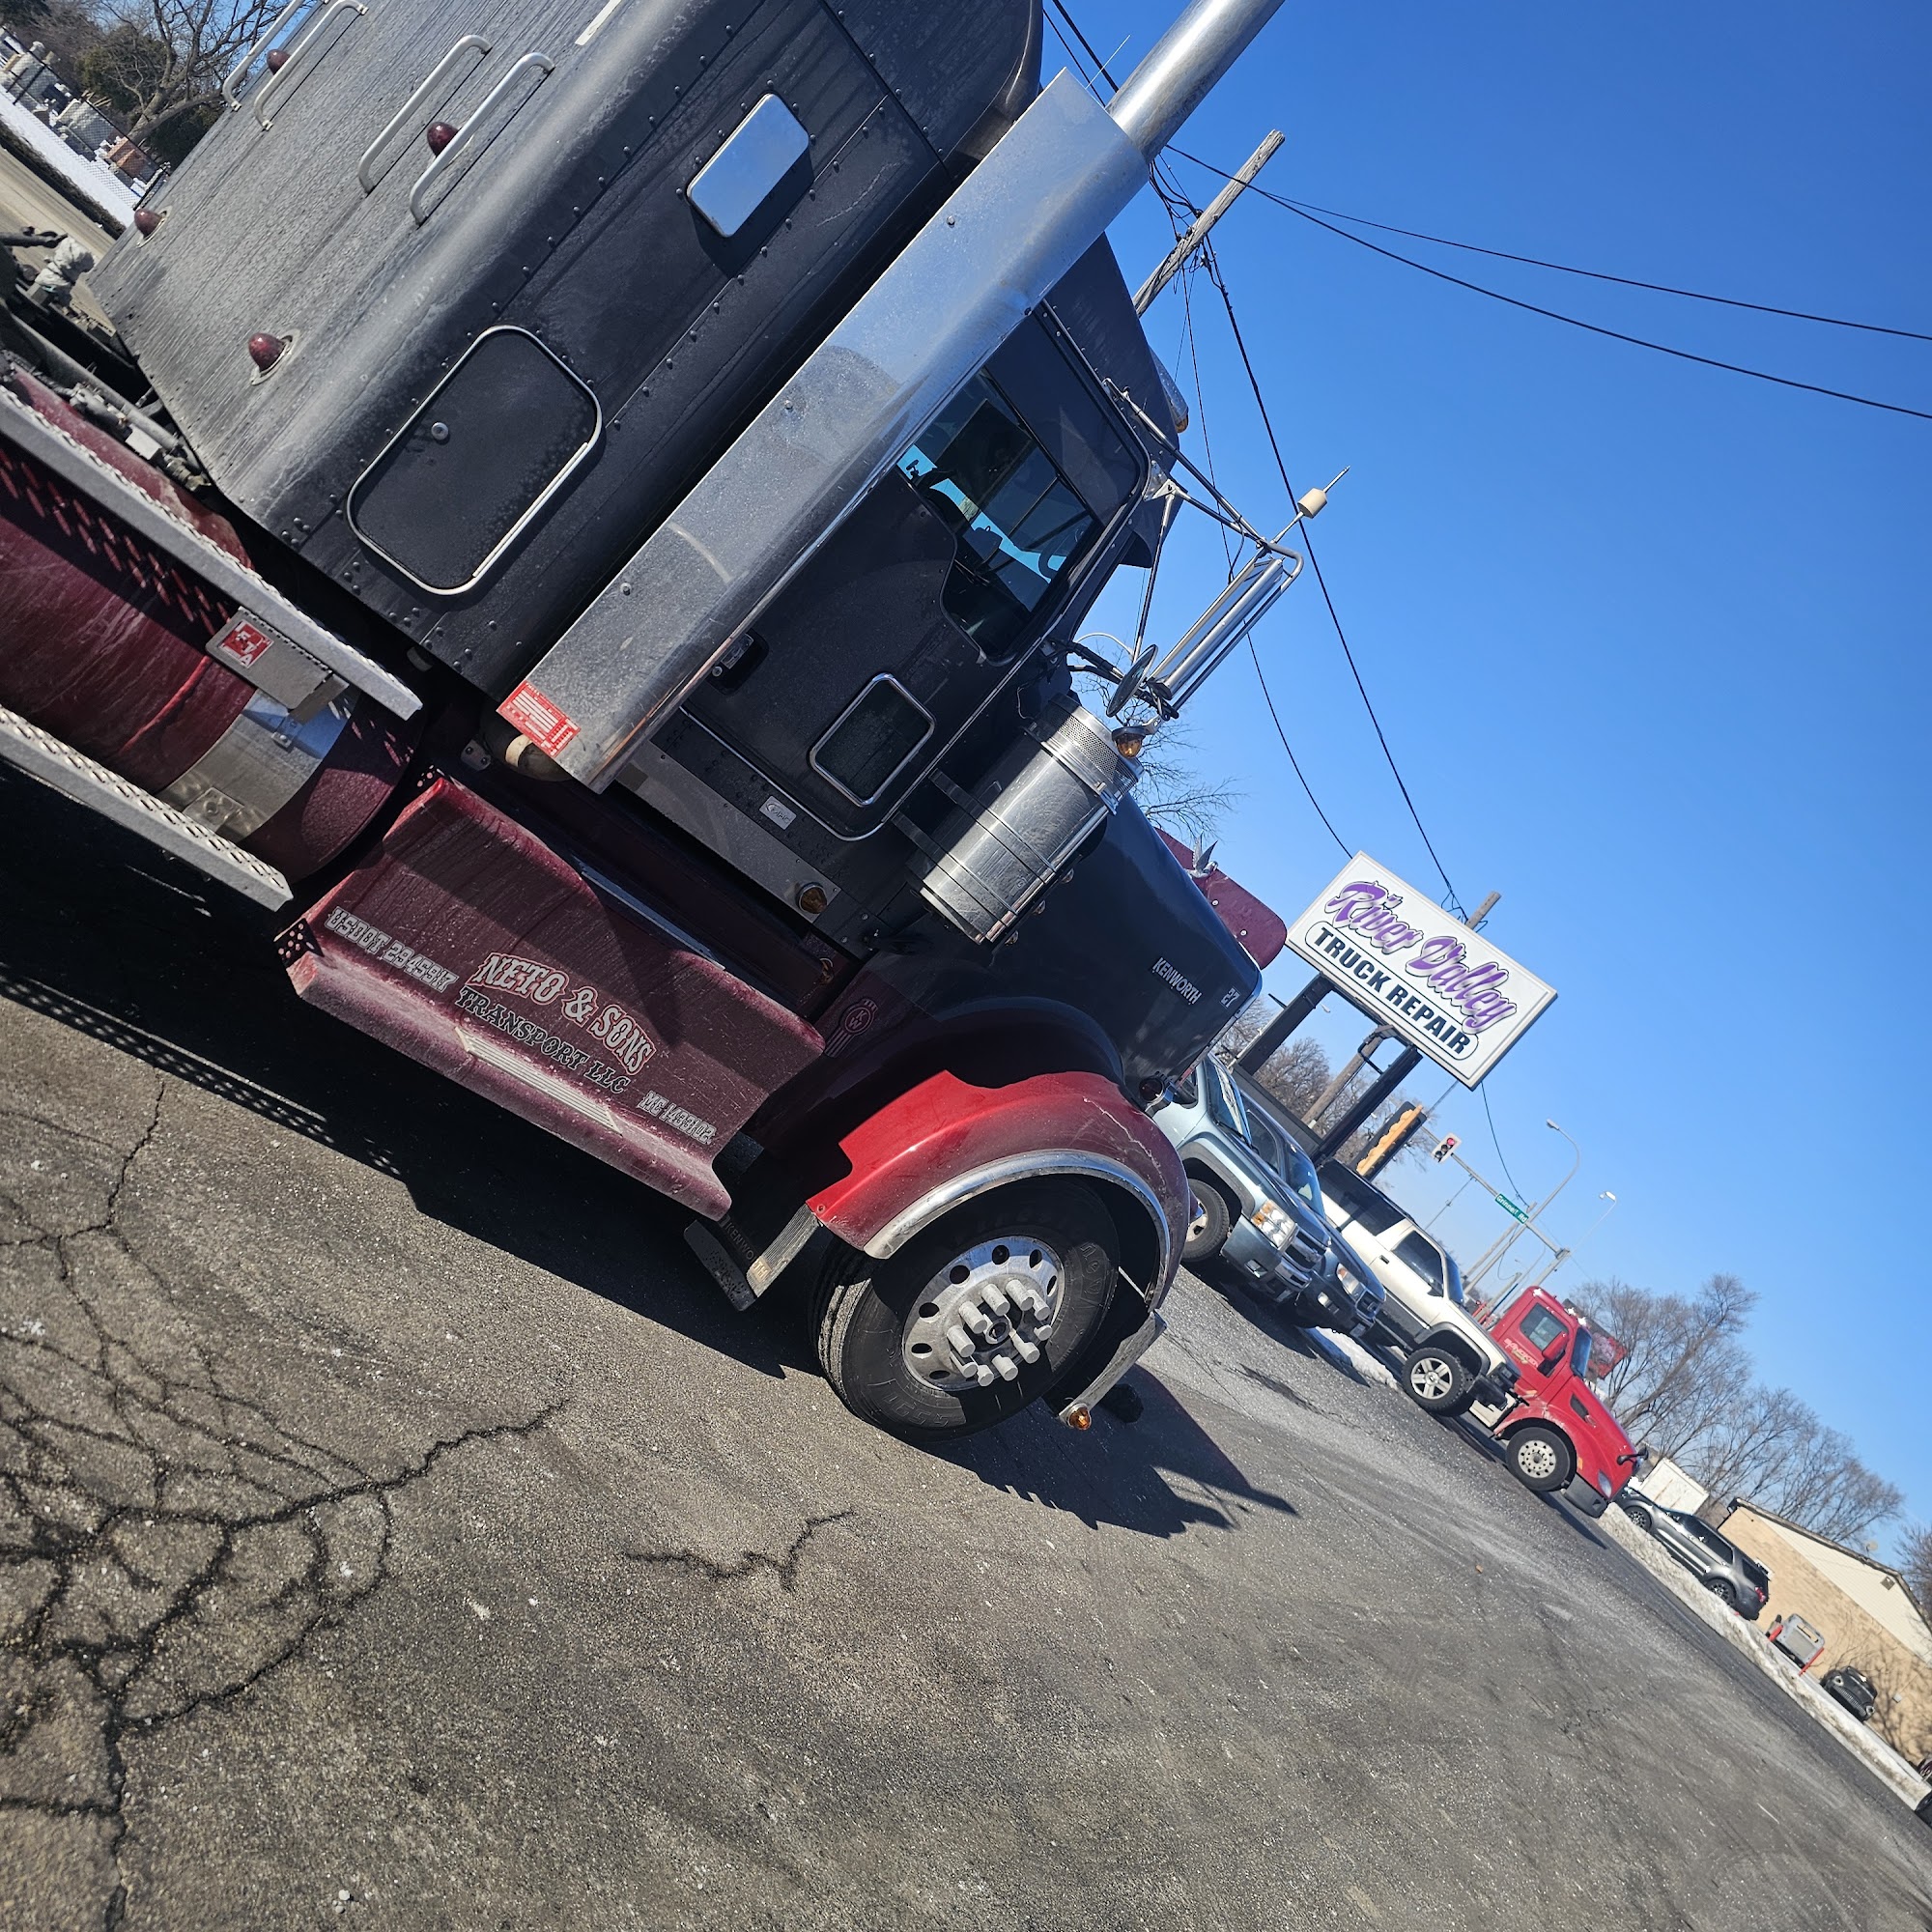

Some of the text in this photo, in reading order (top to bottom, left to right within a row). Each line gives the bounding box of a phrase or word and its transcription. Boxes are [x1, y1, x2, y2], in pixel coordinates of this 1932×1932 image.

[325, 905, 460, 993] USDOT 2945917
[1152, 956, 1203, 1005] KENWORTH
[1314, 926, 1471, 1055] TRUCK REPAIR
[1324, 880, 1518, 1035] River Valley
[455, 985, 631, 1094] TRANSPORT LLC
[466, 952, 657, 1075] NETO & SONS
[1220, 987, 1240, 1008] 27
[637, 1091, 669, 1117] MC
[1518, 1212, 1529, 1224] Rd
